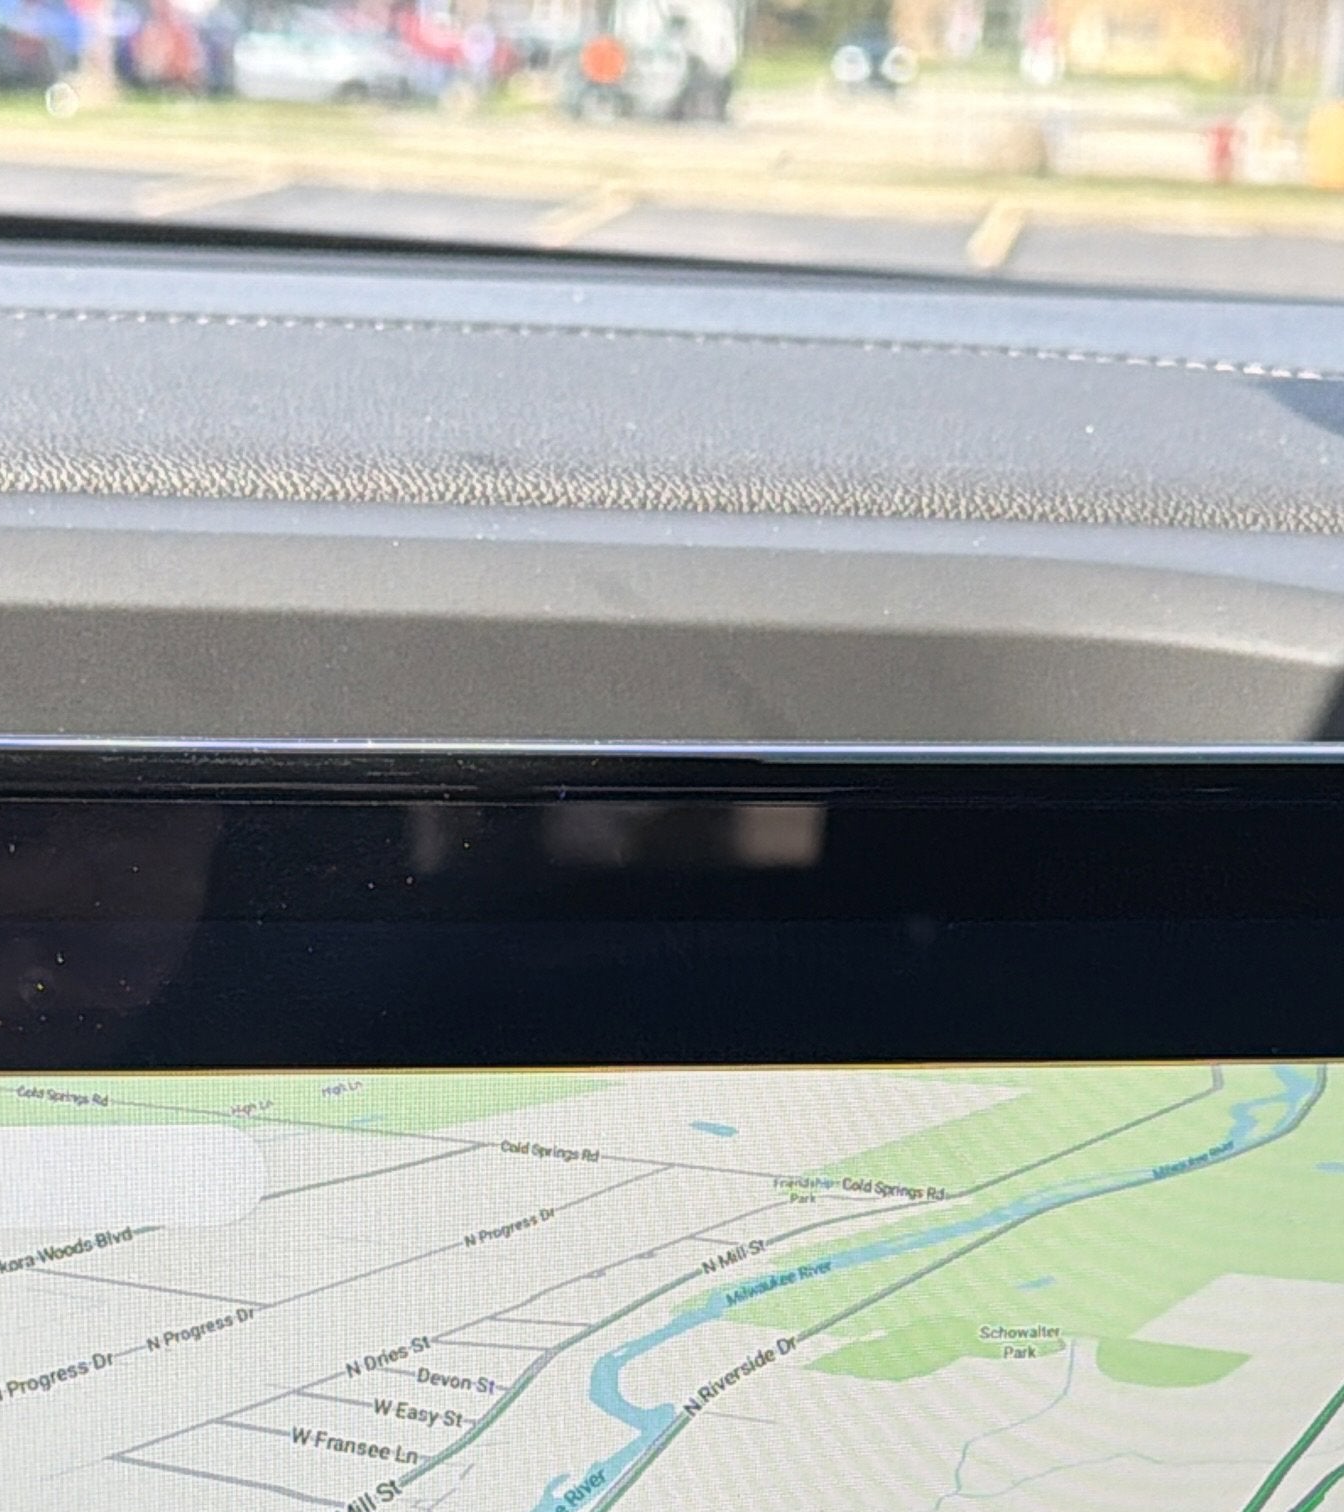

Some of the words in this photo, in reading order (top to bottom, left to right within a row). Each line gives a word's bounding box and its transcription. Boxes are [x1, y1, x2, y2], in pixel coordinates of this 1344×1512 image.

[500, 1140, 530, 1156] Cold
[531, 1144, 580, 1164] Springs
[581, 1148, 600, 1163] Rd
[842, 1176, 872, 1194] Cold
[874, 1181, 924, 1200] Springs
[926, 1187, 946, 1201] Rd
[37, 1238, 94, 1264] Woods
[94, 1226, 134, 1250] Blvd
[464, 1234, 477, 1249] N
[479, 1213, 538, 1245] Progress
[539, 1206, 556, 1222] Dr
[701, 1257, 717, 1275] N
[718, 1244, 747, 1267] Mill
[748, 1237, 767, 1256] St
[725, 1273, 789, 1307] Milwaukee
[789, 1258, 833, 1283] River
[146, 1336, 161, 1352] N
[164, 1315, 234, 1348] Progress
[236, 1306, 255, 1324] Dr
[979, 1324, 1061, 1341] Schowalter
[346, 1361, 362, 1379] N
[363, 1345, 409, 1372] Dries
[410, 1335, 432, 1353] St
[1003, 1344, 1037, 1360] Park
[6, 1360, 90, 1399] Progress
[91, 1351, 115, 1371] Dr
[417, 1366, 473, 1390] Devon
[475, 1376, 496, 1396] St
[683, 1394, 702, 1417] N
[697, 1345, 776, 1401] Riverside
[776, 1333, 799, 1355] Dr
[373, 1398, 391, 1415] W
[394, 1401, 440, 1428] Easy
[441, 1410, 464, 1429] St
[291, 1426, 310, 1446] W
[312, 1431, 391, 1461] Fransee
[394, 1444, 419, 1465] Ln
[375, 1477, 403, 1502] St
[563, 1468, 608, 1508] River
